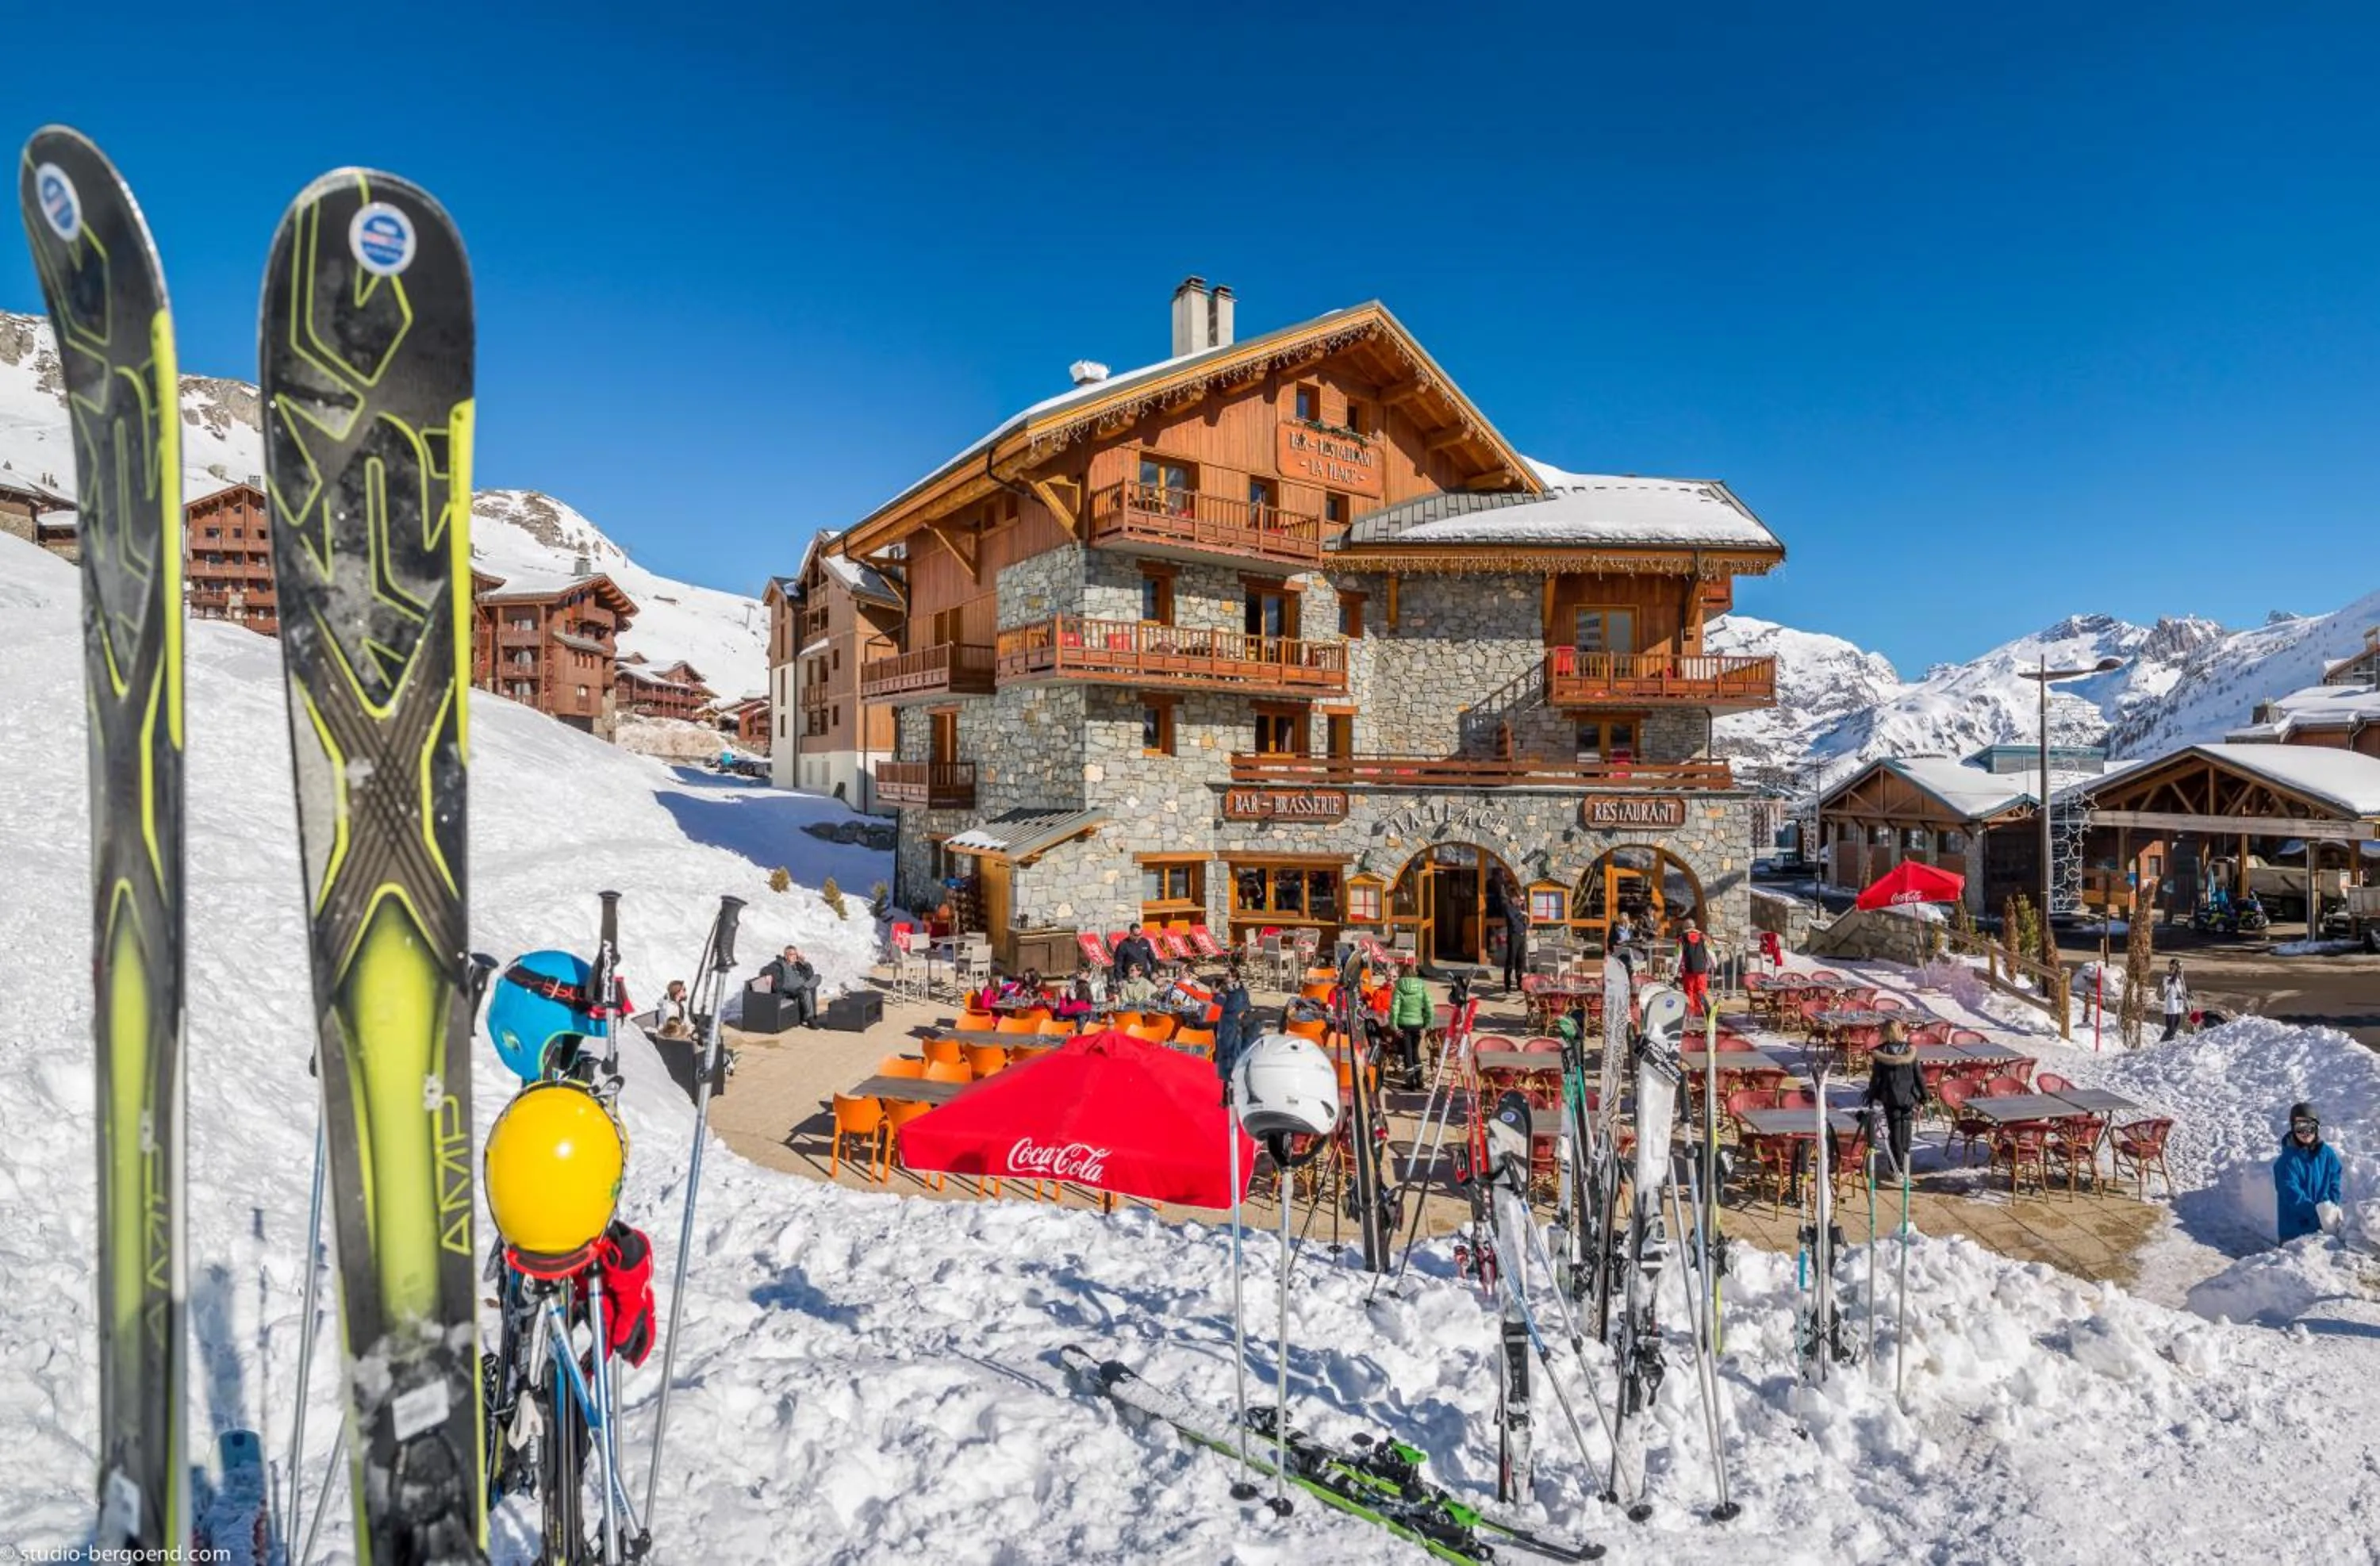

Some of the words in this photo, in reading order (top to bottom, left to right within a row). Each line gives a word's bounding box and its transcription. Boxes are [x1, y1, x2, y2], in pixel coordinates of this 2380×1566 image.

[1235, 794, 1259, 813] BAR
[1275, 796, 1340, 815] BRASSERIE
[1595, 802, 1676, 823] RESTAURANT
[1007, 1136, 1112, 1183] Coca-Cola
